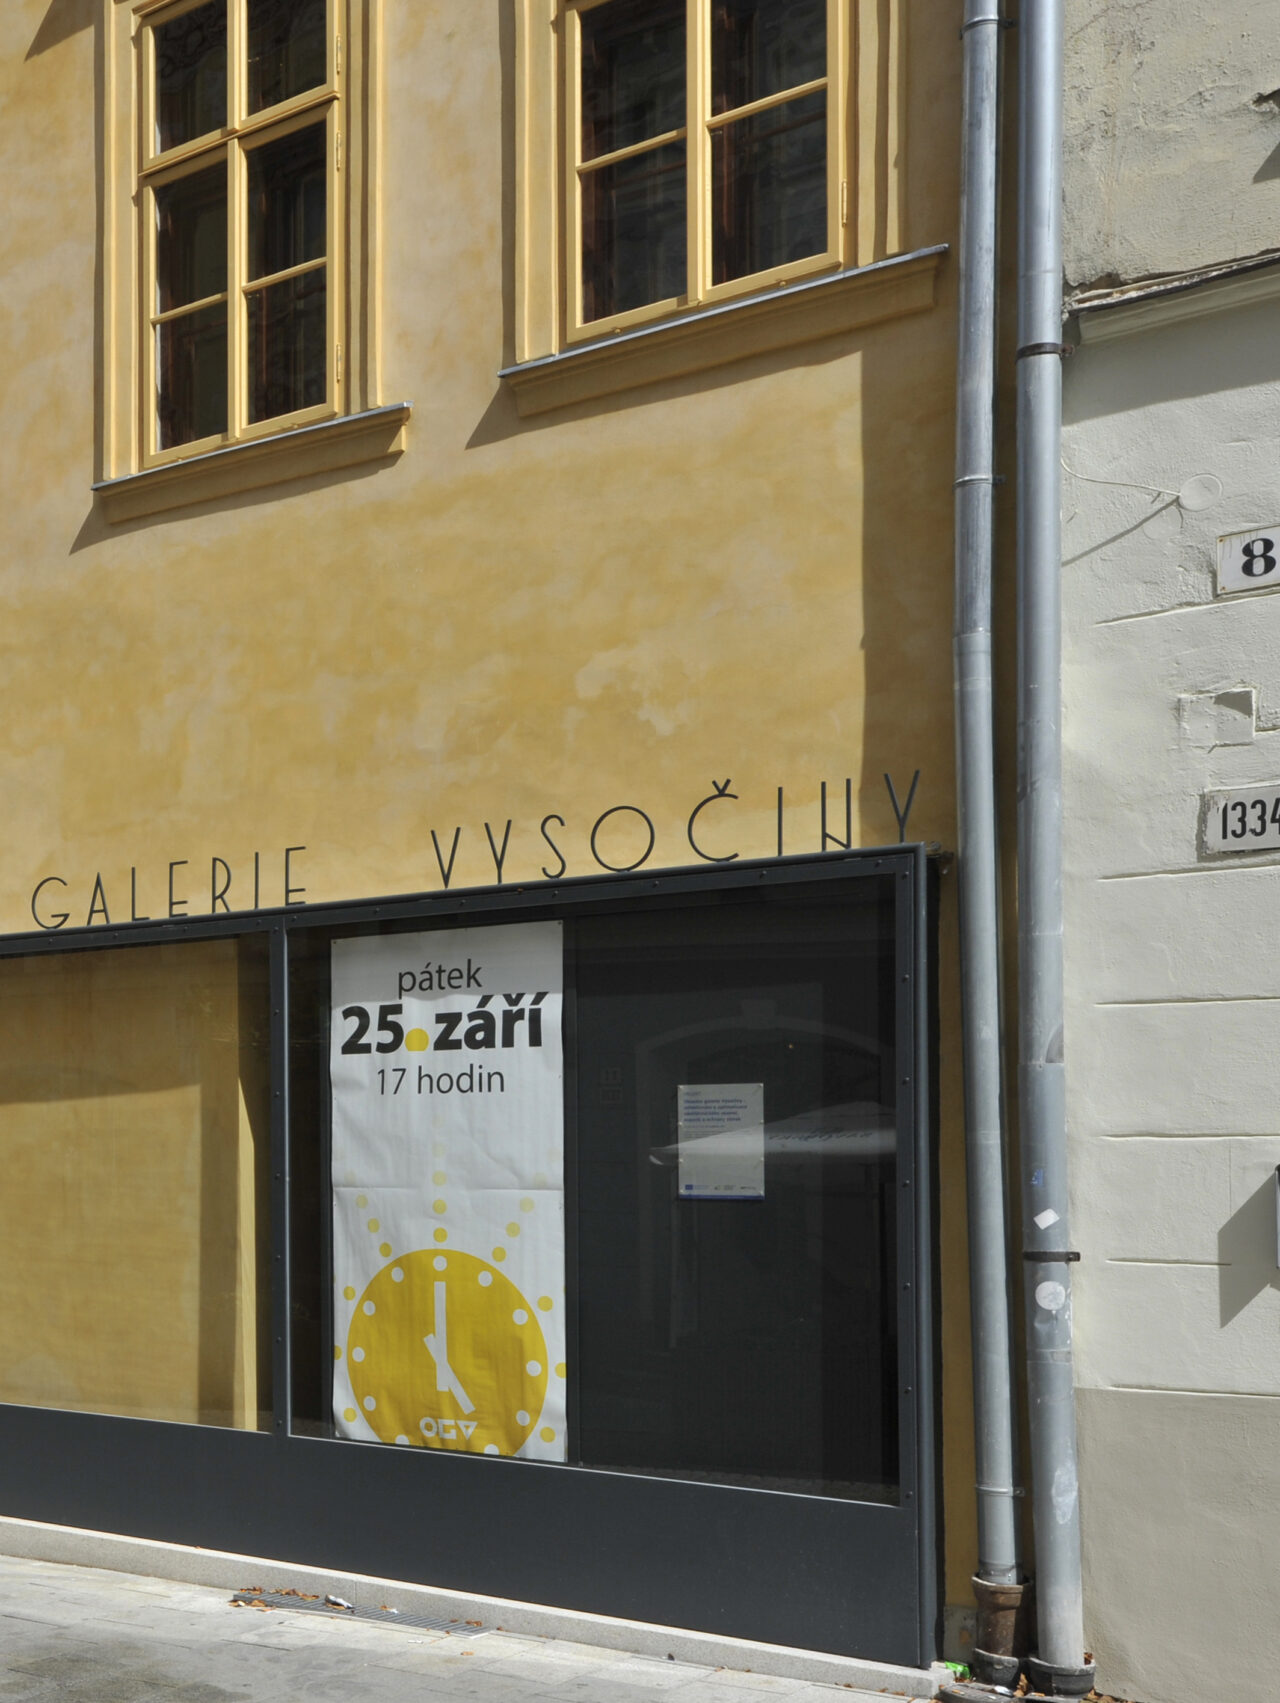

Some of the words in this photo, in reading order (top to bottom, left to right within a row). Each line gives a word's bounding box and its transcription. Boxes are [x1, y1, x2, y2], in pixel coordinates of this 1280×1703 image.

[1241, 537, 1277, 578] 8
[30, 846, 308, 931] GALERIE
[430, 769, 921, 889] VYSOČINY
[397, 958, 483, 1000] pátek
[432, 991, 549, 1051] září
[376, 1067, 407, 1096] 17
[417, 1063, 505, 1095] hodin
